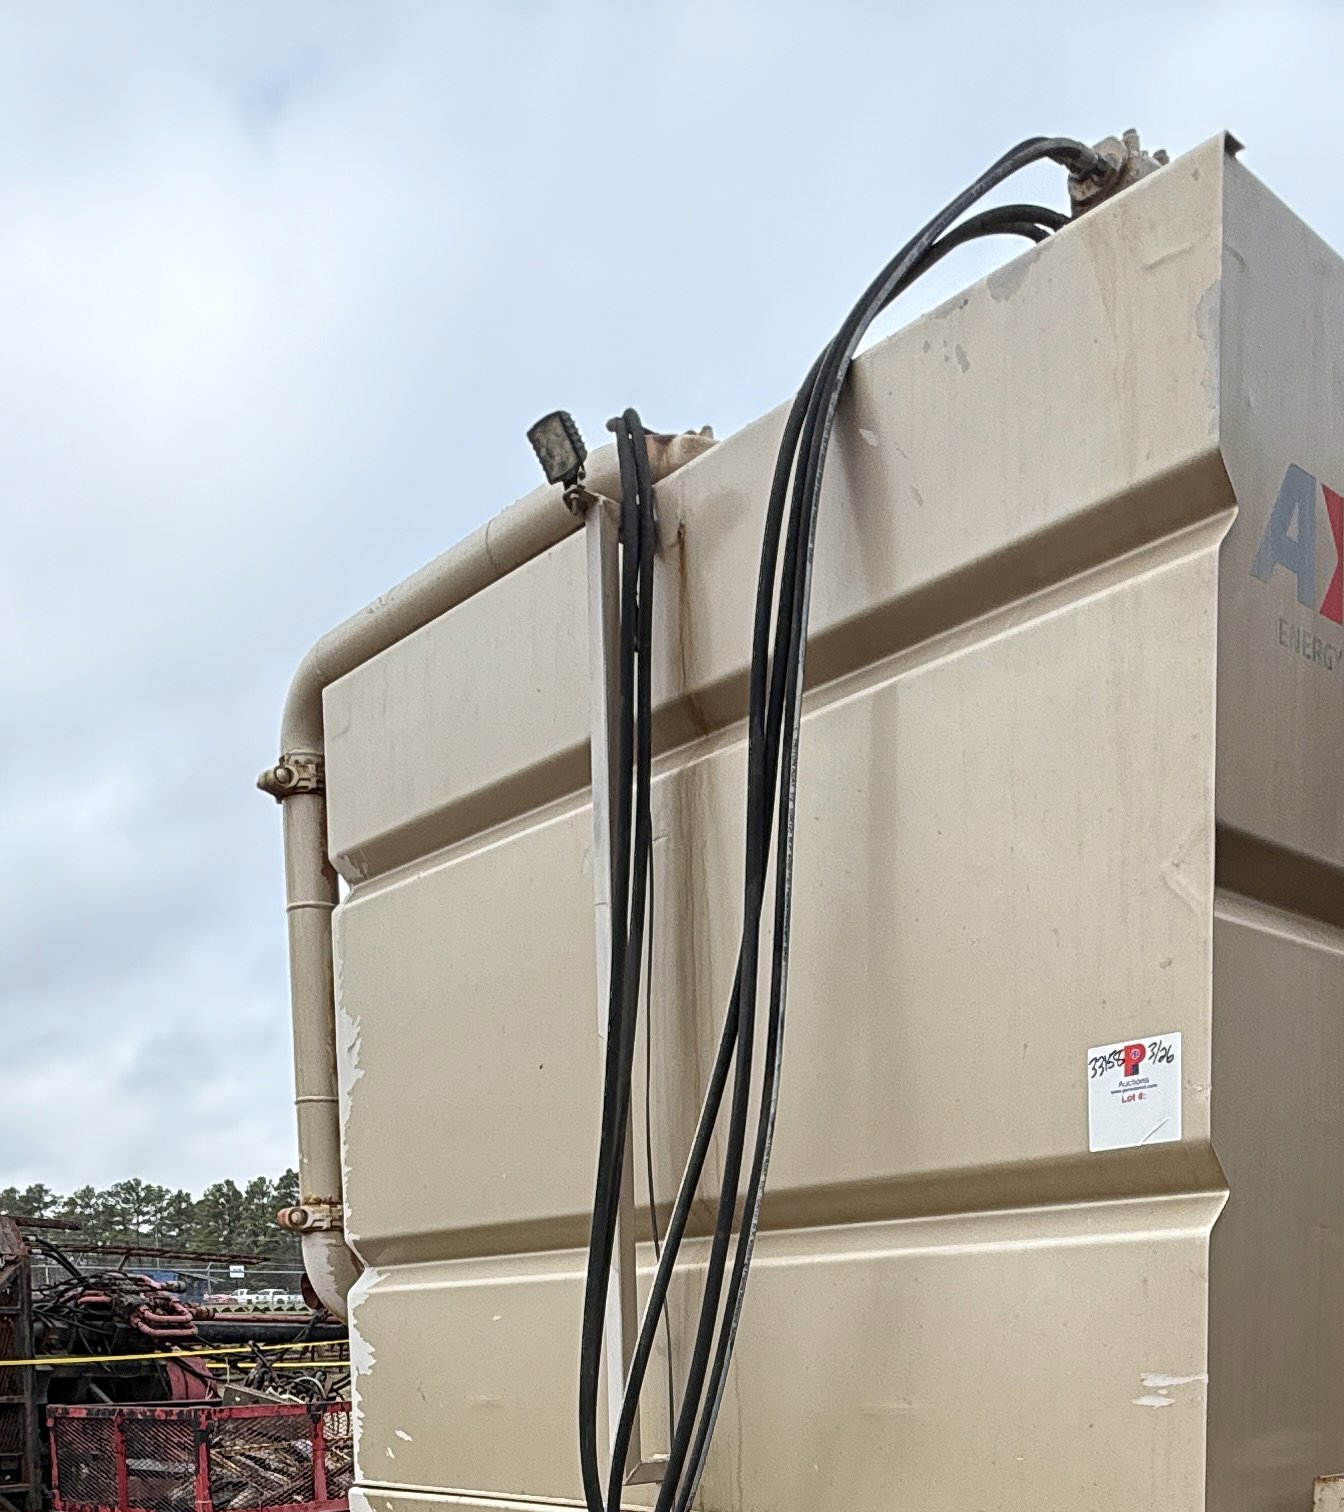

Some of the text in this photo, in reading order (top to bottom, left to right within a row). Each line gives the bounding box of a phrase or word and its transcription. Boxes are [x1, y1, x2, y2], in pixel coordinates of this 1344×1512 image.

[1277, 617, 1343, 672] ENERGY
[1147, 1040, 1175, 1065] 3/26
[1121, 1092, 1136, 1104] Lot
